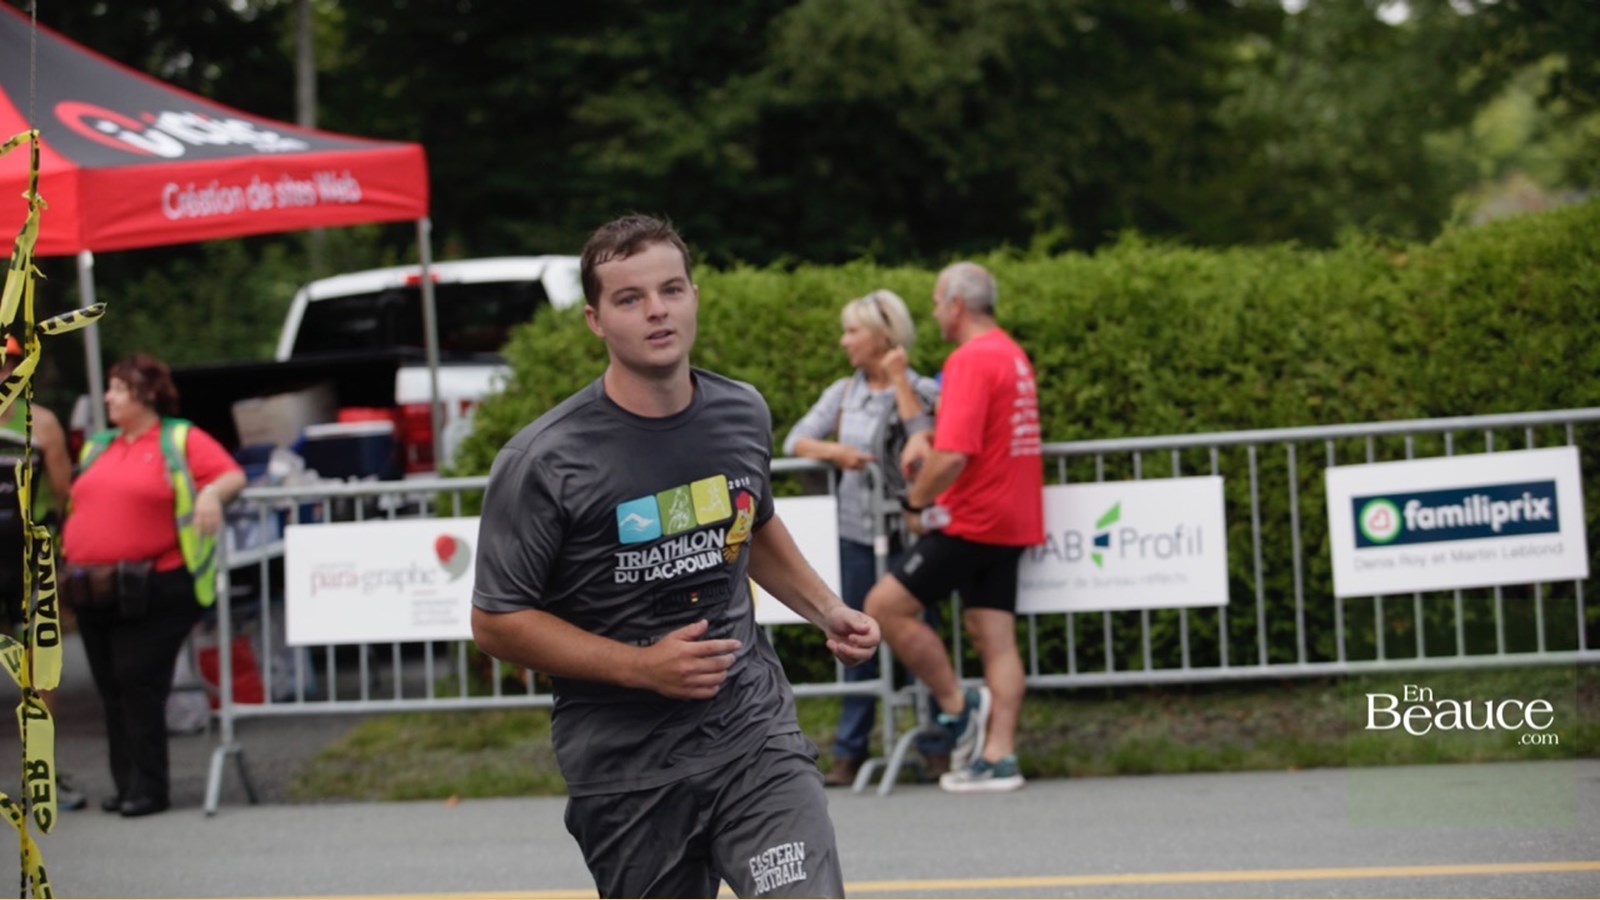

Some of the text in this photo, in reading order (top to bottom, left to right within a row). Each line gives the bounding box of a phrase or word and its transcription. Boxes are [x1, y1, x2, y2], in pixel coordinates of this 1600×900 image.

[162, 170, 362, 220] Création de sites Web
[1403, 491, 1552, 533] familiprix
[614, 528, 725, 569] TRIATHLON
[1119, 523, 1204, 560] Profil
[614, 550, 724, 584] DU LAC-POULIN
[749, 842, 805, 877] EASTERN
